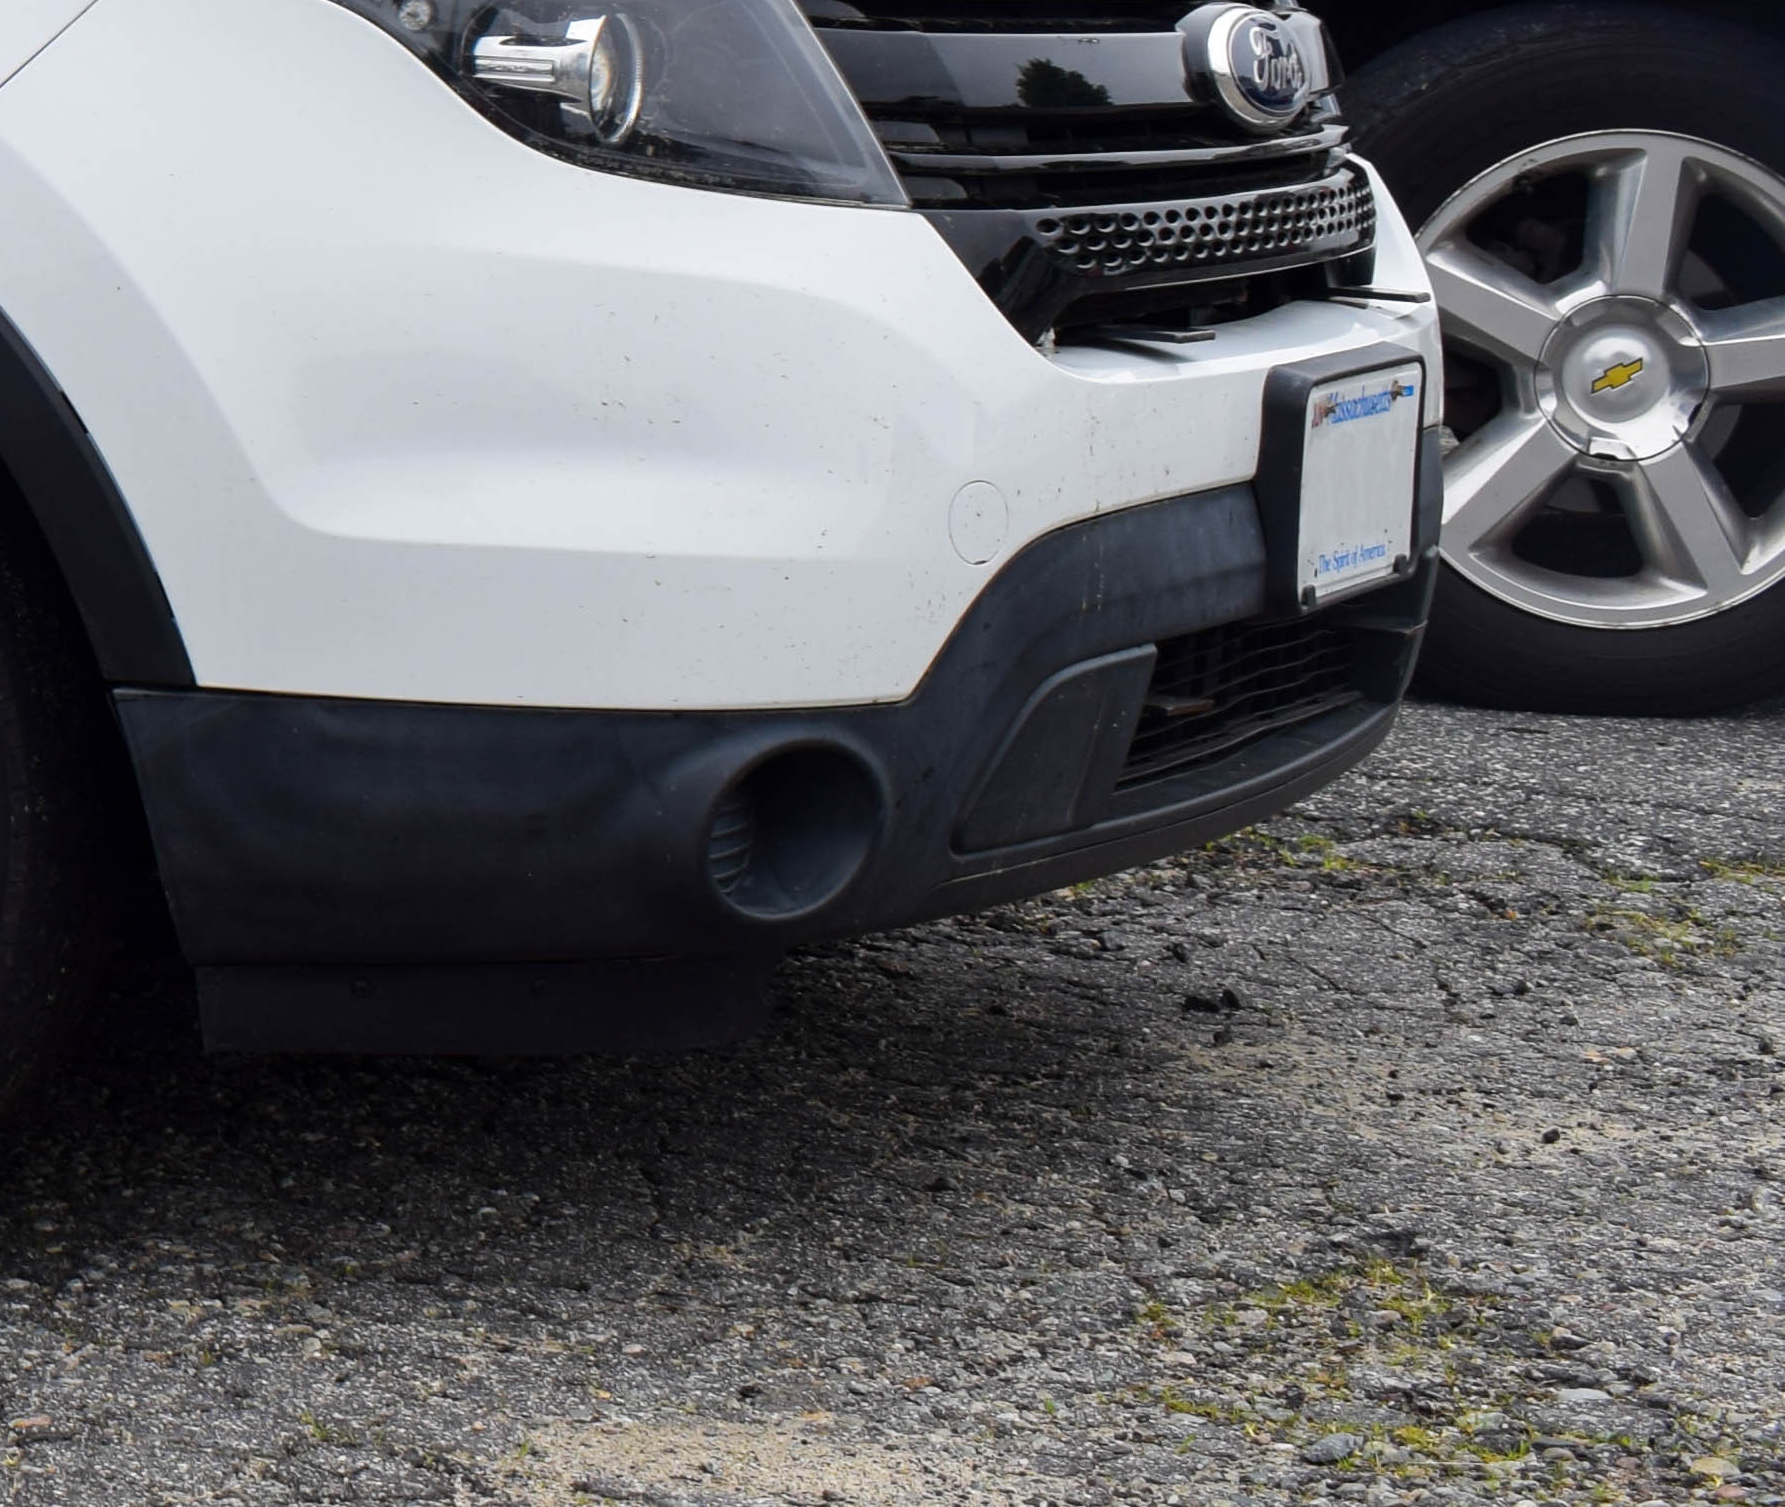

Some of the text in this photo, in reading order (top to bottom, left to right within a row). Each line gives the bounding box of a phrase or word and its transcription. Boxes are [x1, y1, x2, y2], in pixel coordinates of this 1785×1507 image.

[1250, 27, 1303, 91] Ford
[1318, 553, 1331, 574] The
[1332, 548, 1350, 572] Spirit
[1359, 541, 1386, 560] America
